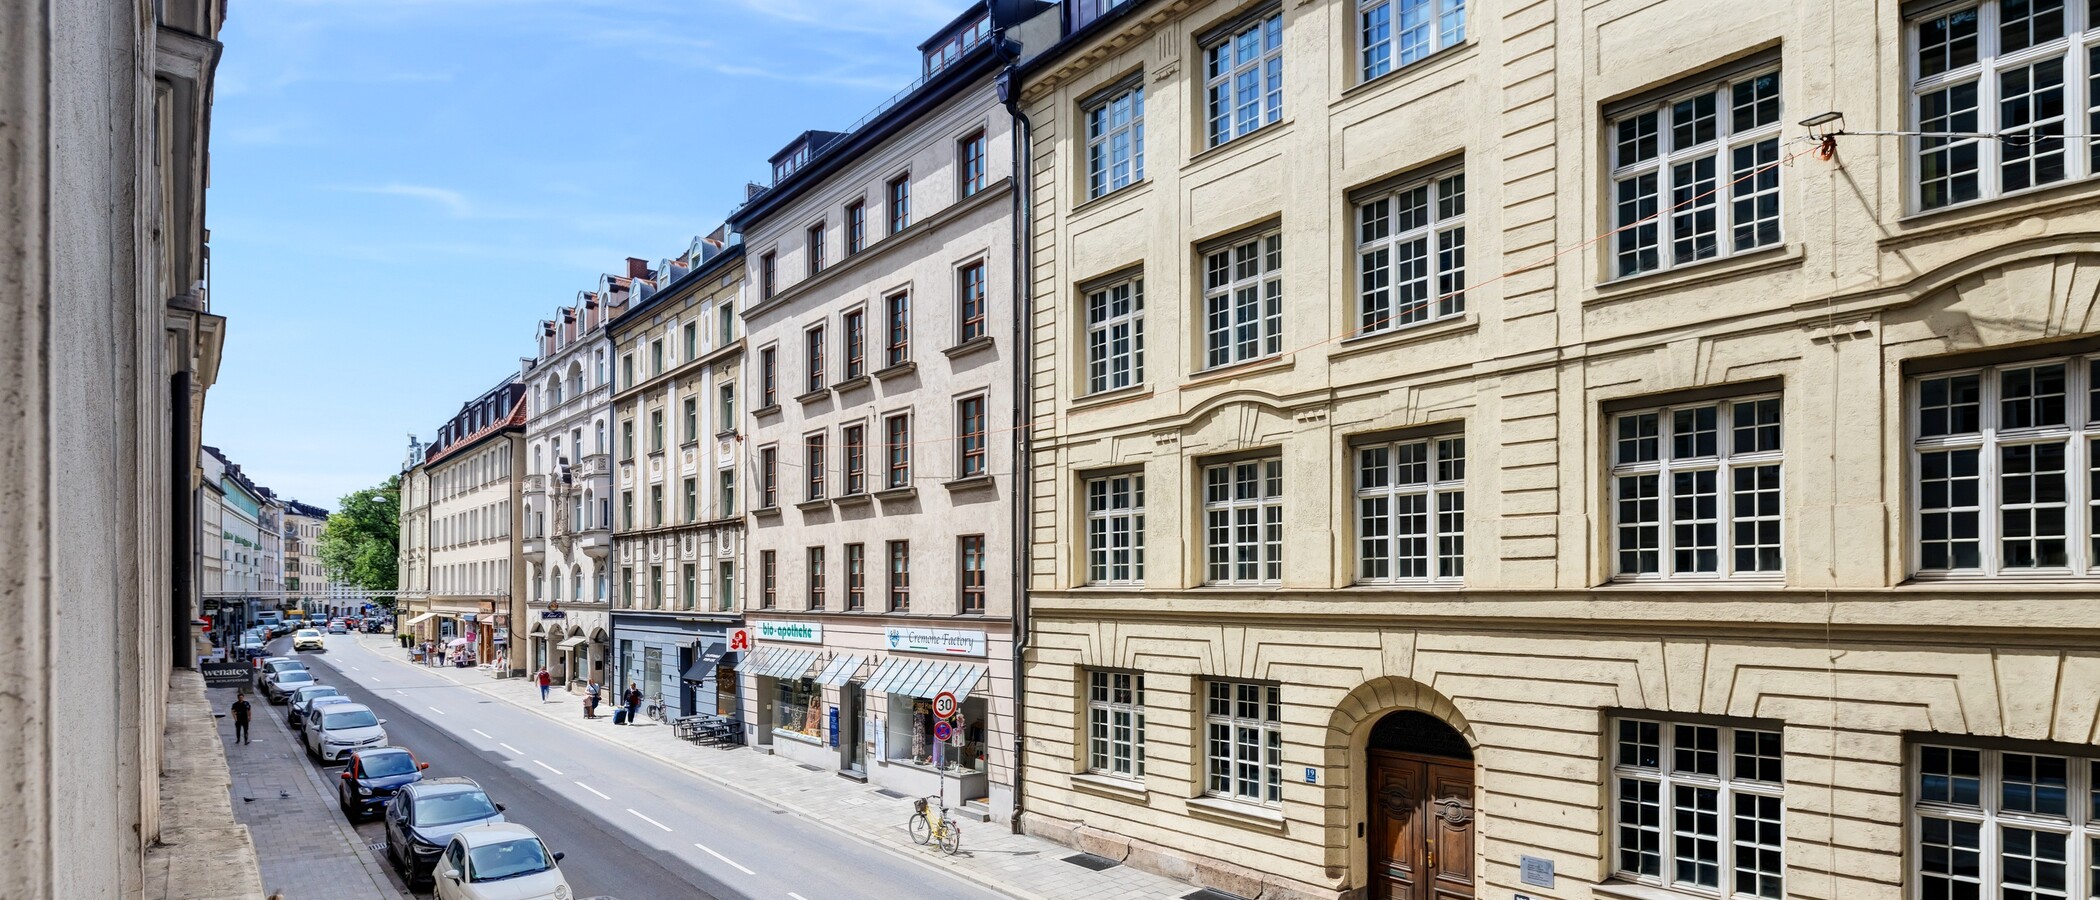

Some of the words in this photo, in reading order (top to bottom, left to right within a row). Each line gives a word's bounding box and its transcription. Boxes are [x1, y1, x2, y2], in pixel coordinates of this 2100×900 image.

[908, 631, 940, 645] Cremone
[942, 633, 974, 653] Factory
[204, 668, 249, 676] wenatex
[937, 698, 952, 712] 30
[1307, 768, 1315, 776] 19
